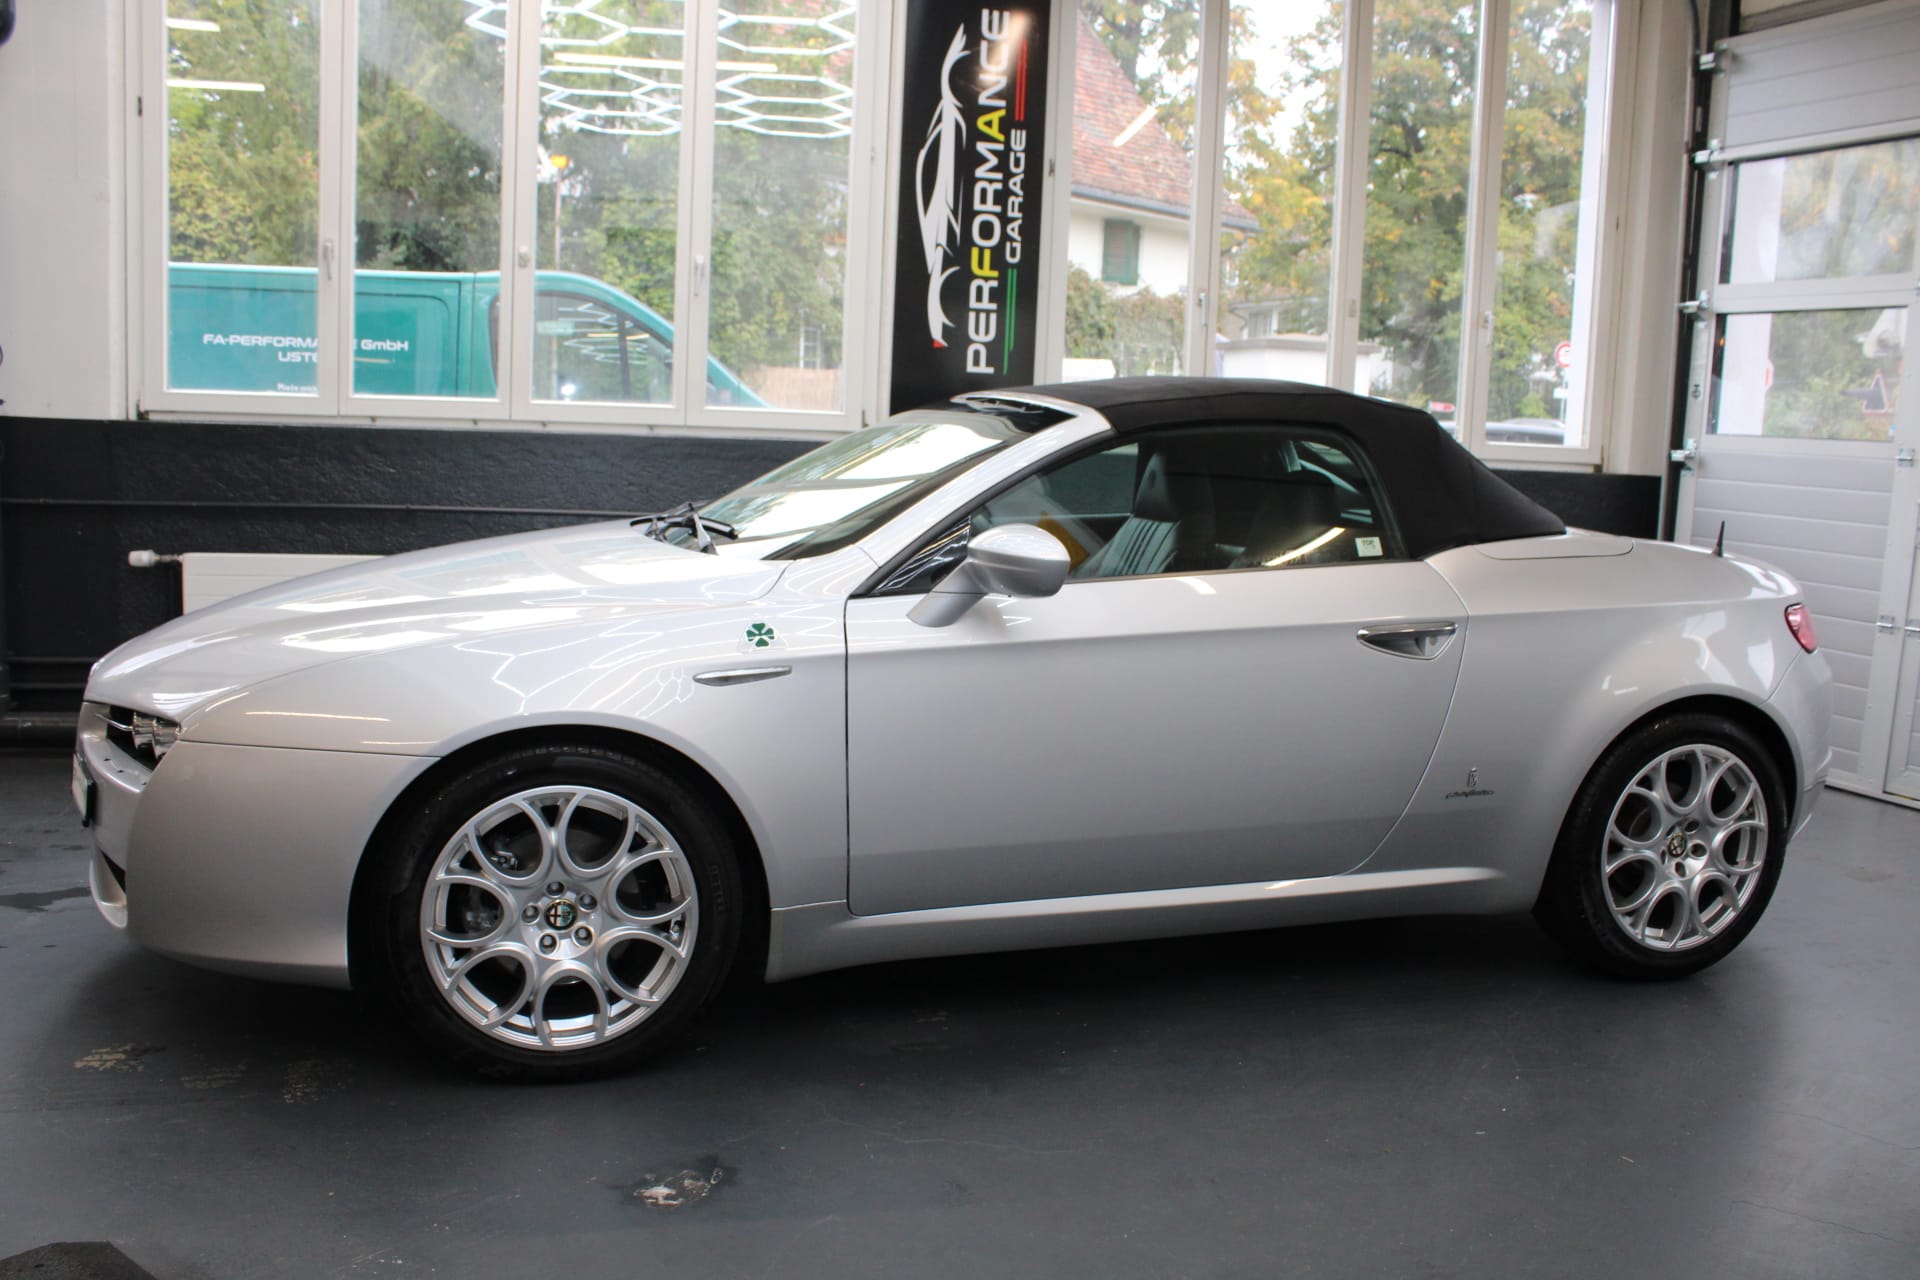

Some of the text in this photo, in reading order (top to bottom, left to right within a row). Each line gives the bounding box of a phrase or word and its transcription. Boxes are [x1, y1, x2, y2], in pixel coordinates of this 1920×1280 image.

[966, 8, 1010, 374] PERFORMANCE
[1005, 128, 1027, 264] GARAGE
[278, 351, 319, 363] USTE
[360, 339, 409, 351] GmbH
